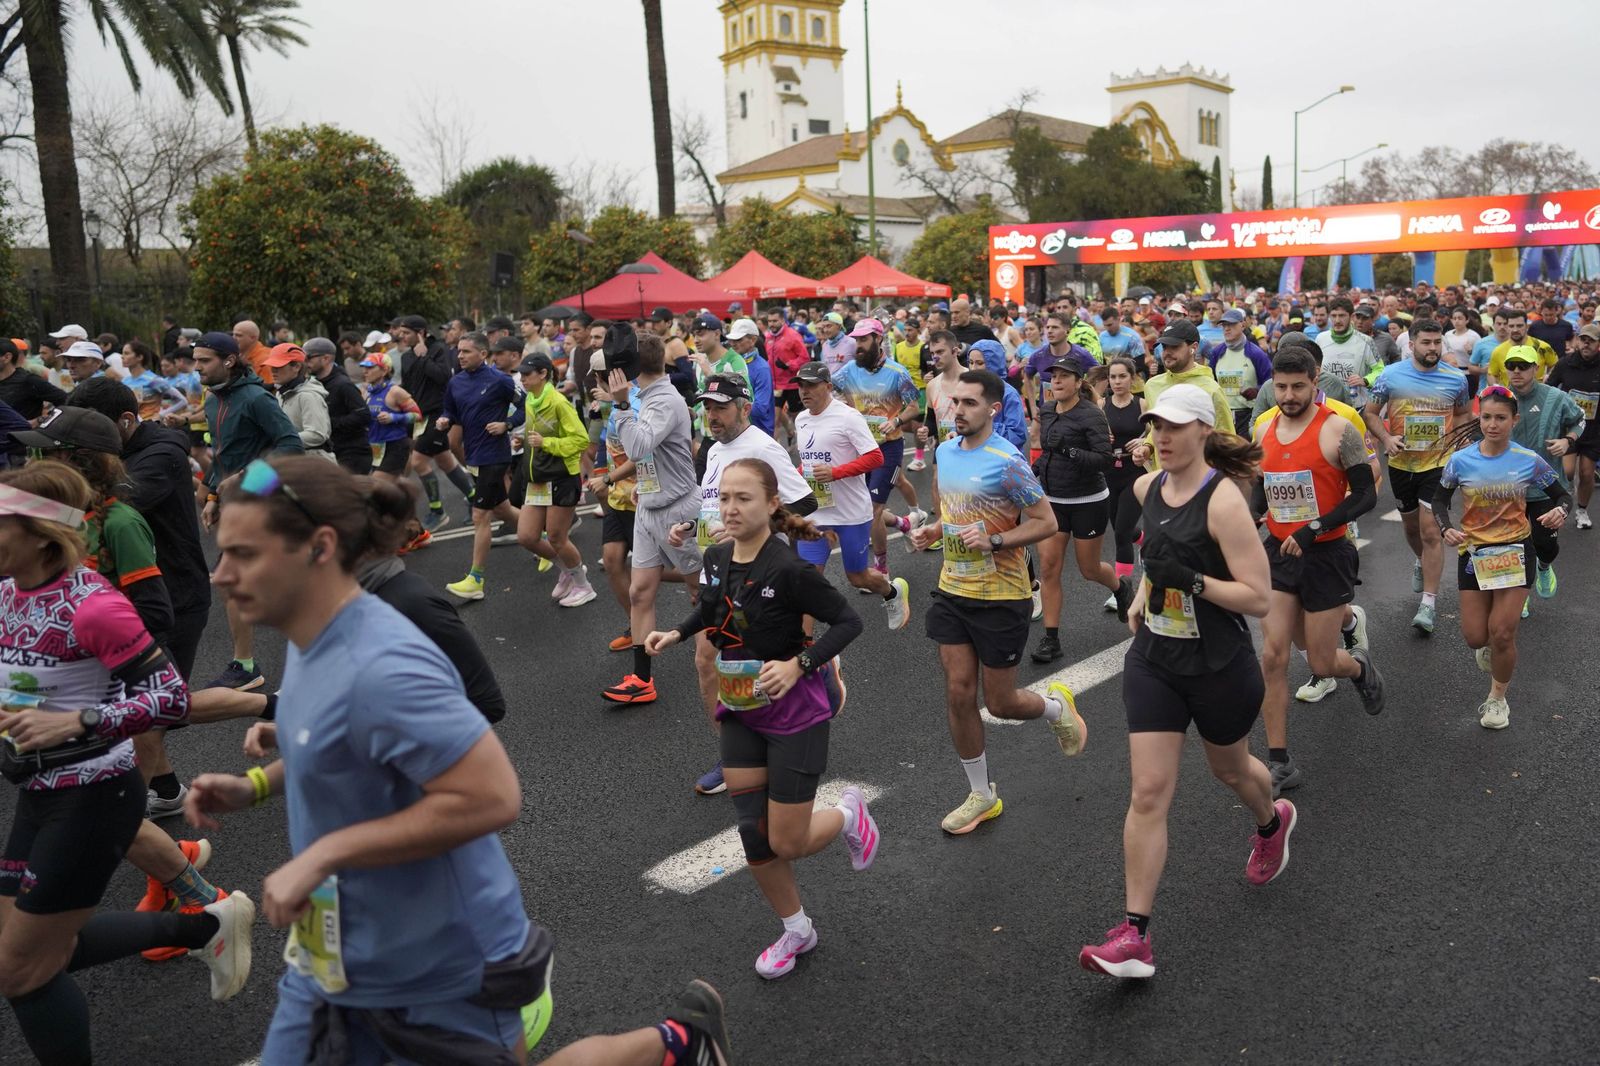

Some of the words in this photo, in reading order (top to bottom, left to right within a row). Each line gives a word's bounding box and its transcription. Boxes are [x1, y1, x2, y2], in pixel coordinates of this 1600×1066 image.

[1408, 424, 1440, 436] 12429
[1266, 484, 1305, 502] 19991
[1478, 552, 1521, 572] 13285
